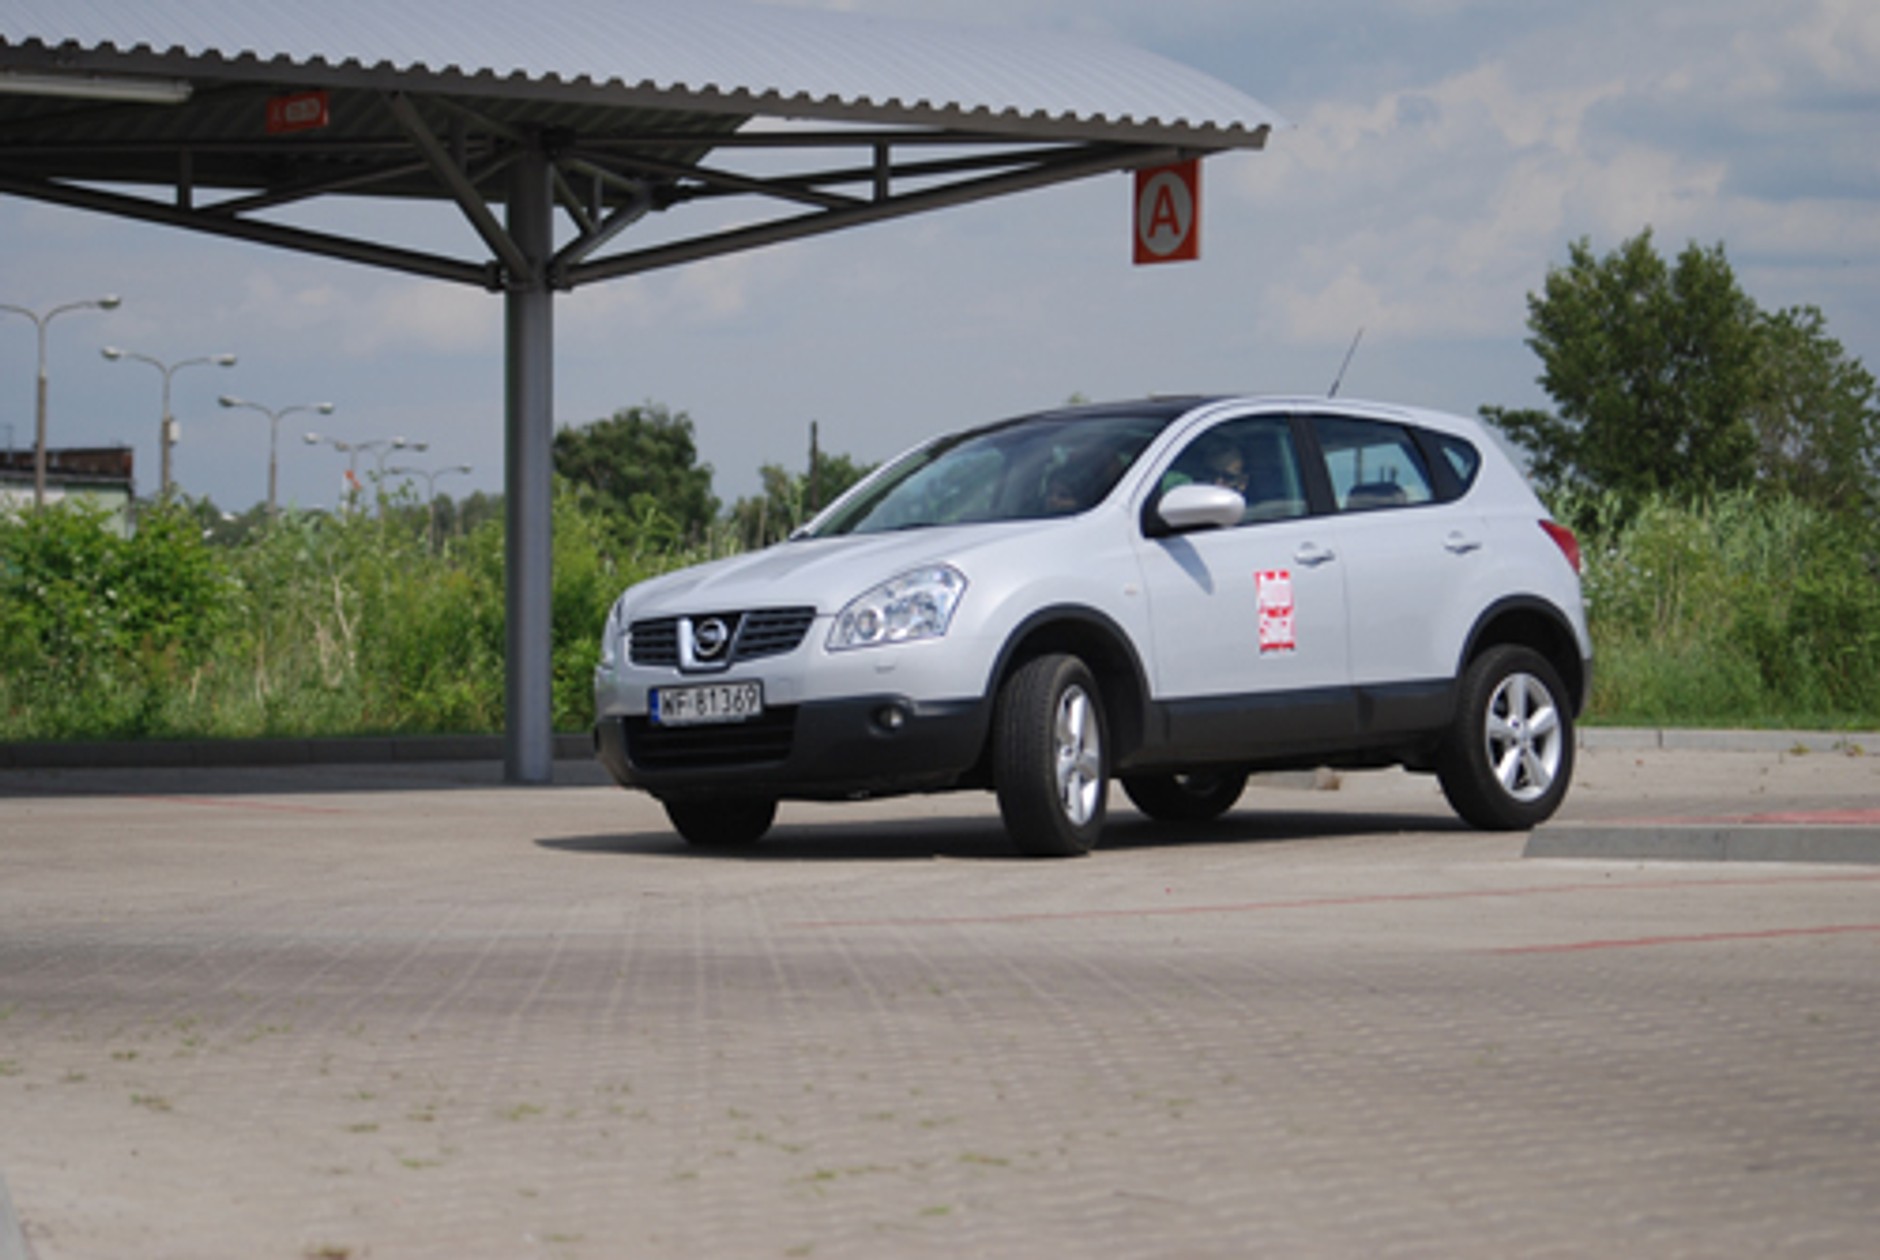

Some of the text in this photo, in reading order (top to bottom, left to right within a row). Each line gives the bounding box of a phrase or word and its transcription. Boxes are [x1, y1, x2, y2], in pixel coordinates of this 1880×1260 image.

[1147, 183, 1181, 239] A
[661, 684, 757, 716] WF 81369
